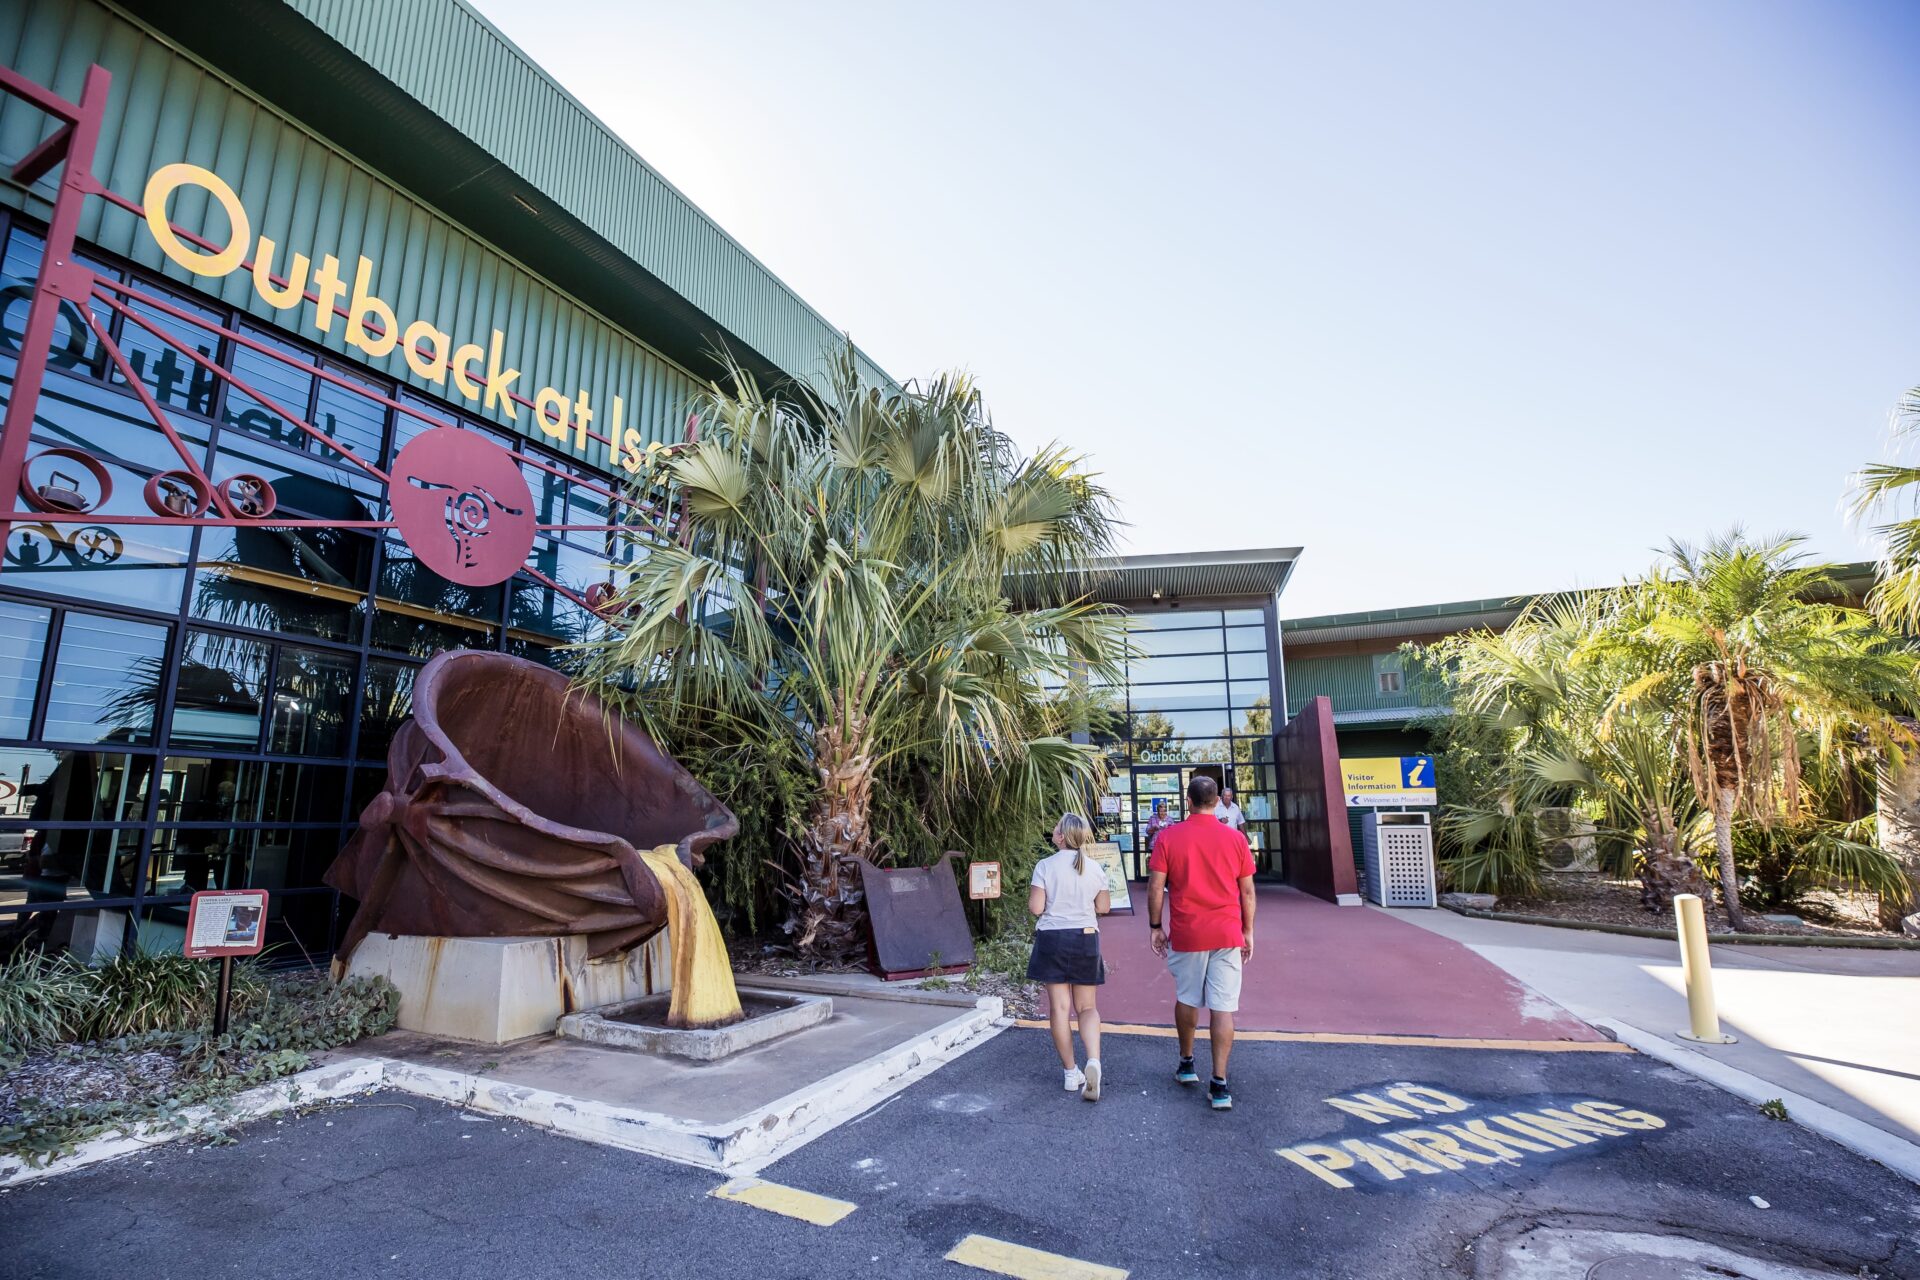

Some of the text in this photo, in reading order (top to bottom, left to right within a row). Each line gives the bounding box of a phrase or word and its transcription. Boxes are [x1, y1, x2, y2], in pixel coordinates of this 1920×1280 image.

[143, 163, 521, 420] Outback
[535, 386, 593, 451] at
[1140, 748, 1188, 763] Outback
[1347, 773, 1375, 781] Visitor
[1347, 782, 1397, 791] Information
[1400, 795, 1420, 803] Mount
[1321, 1081, 1474, 1125] NO
[1275, 1101, 1667, 1189] PARKING
